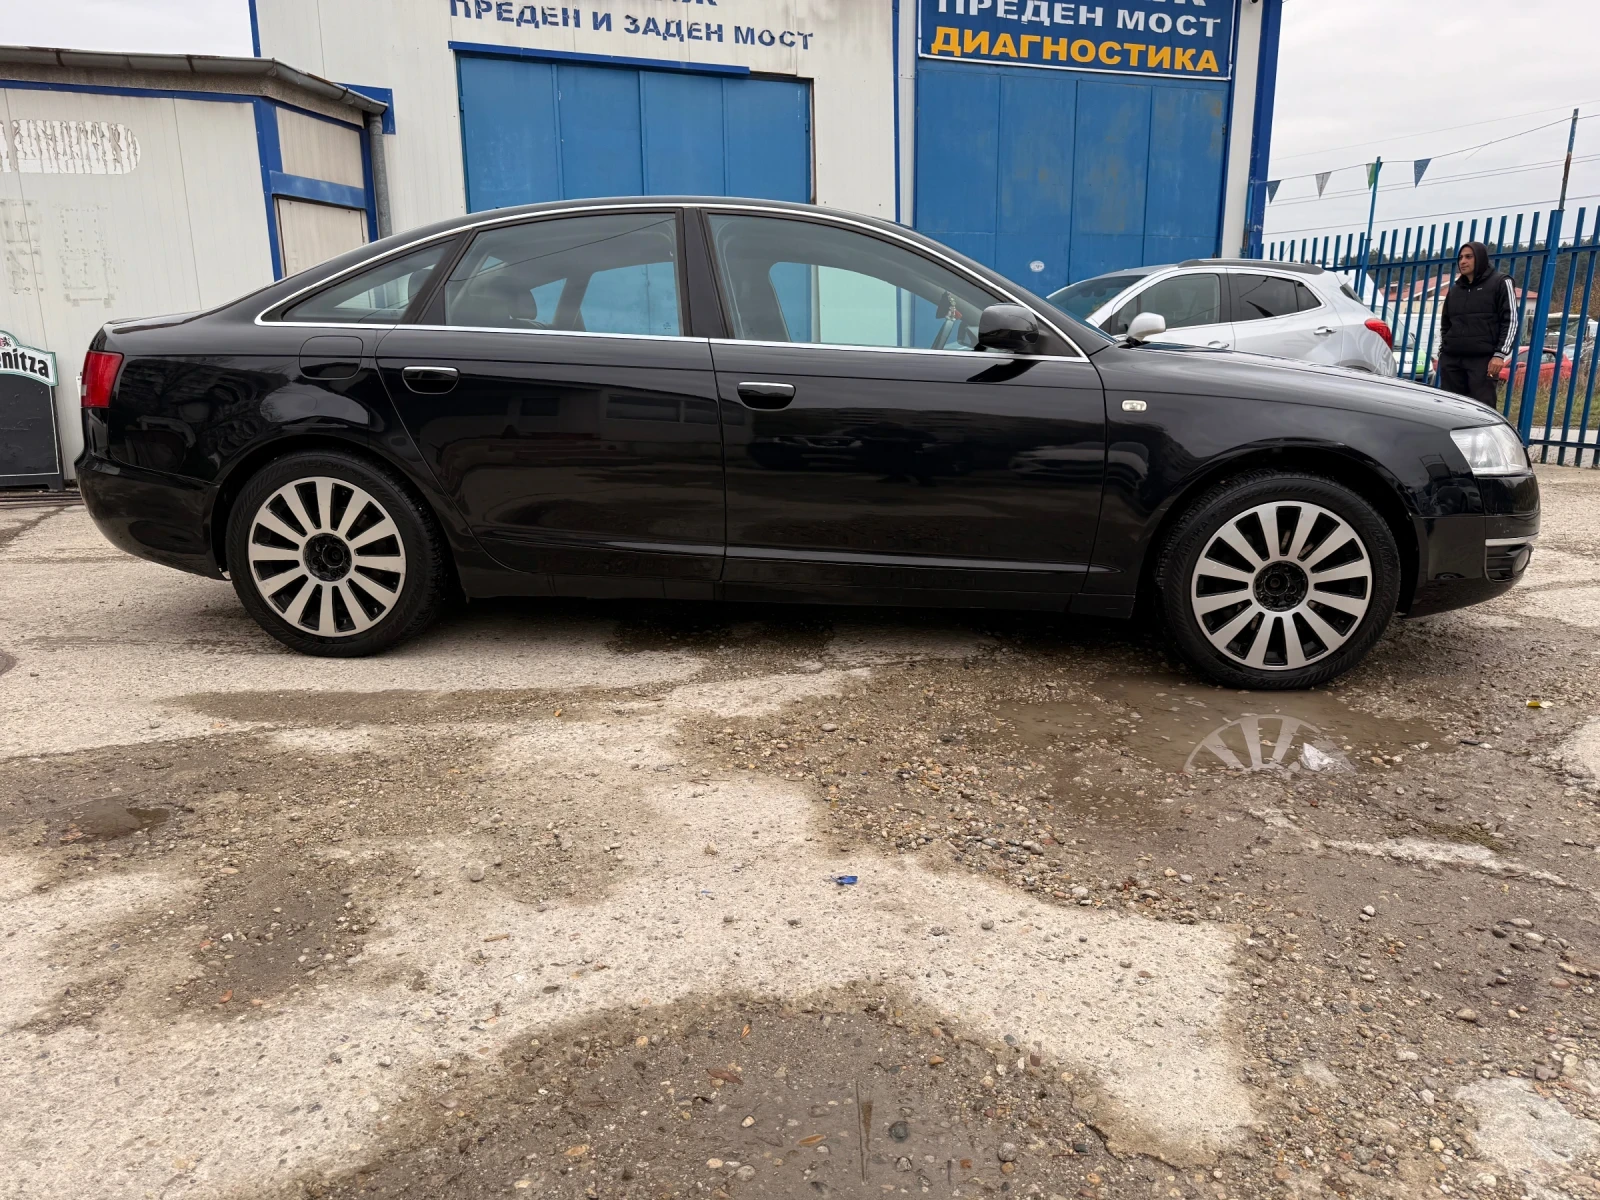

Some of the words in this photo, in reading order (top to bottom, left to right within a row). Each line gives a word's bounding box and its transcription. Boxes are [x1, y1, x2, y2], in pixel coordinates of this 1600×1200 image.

[450, 0, 581, 29] ПРЕДЕН
[592, 11, 612, 32] И
[624, 14, 724, 43] ЗАДЕН
[734, 25, 814, 50] МОСТ
[1116, 9, 1221, 38] МОСТ
[931, 26, 1220, 73] ДИАГНОСТИКА
[0, 348, 50, 379] nitza
